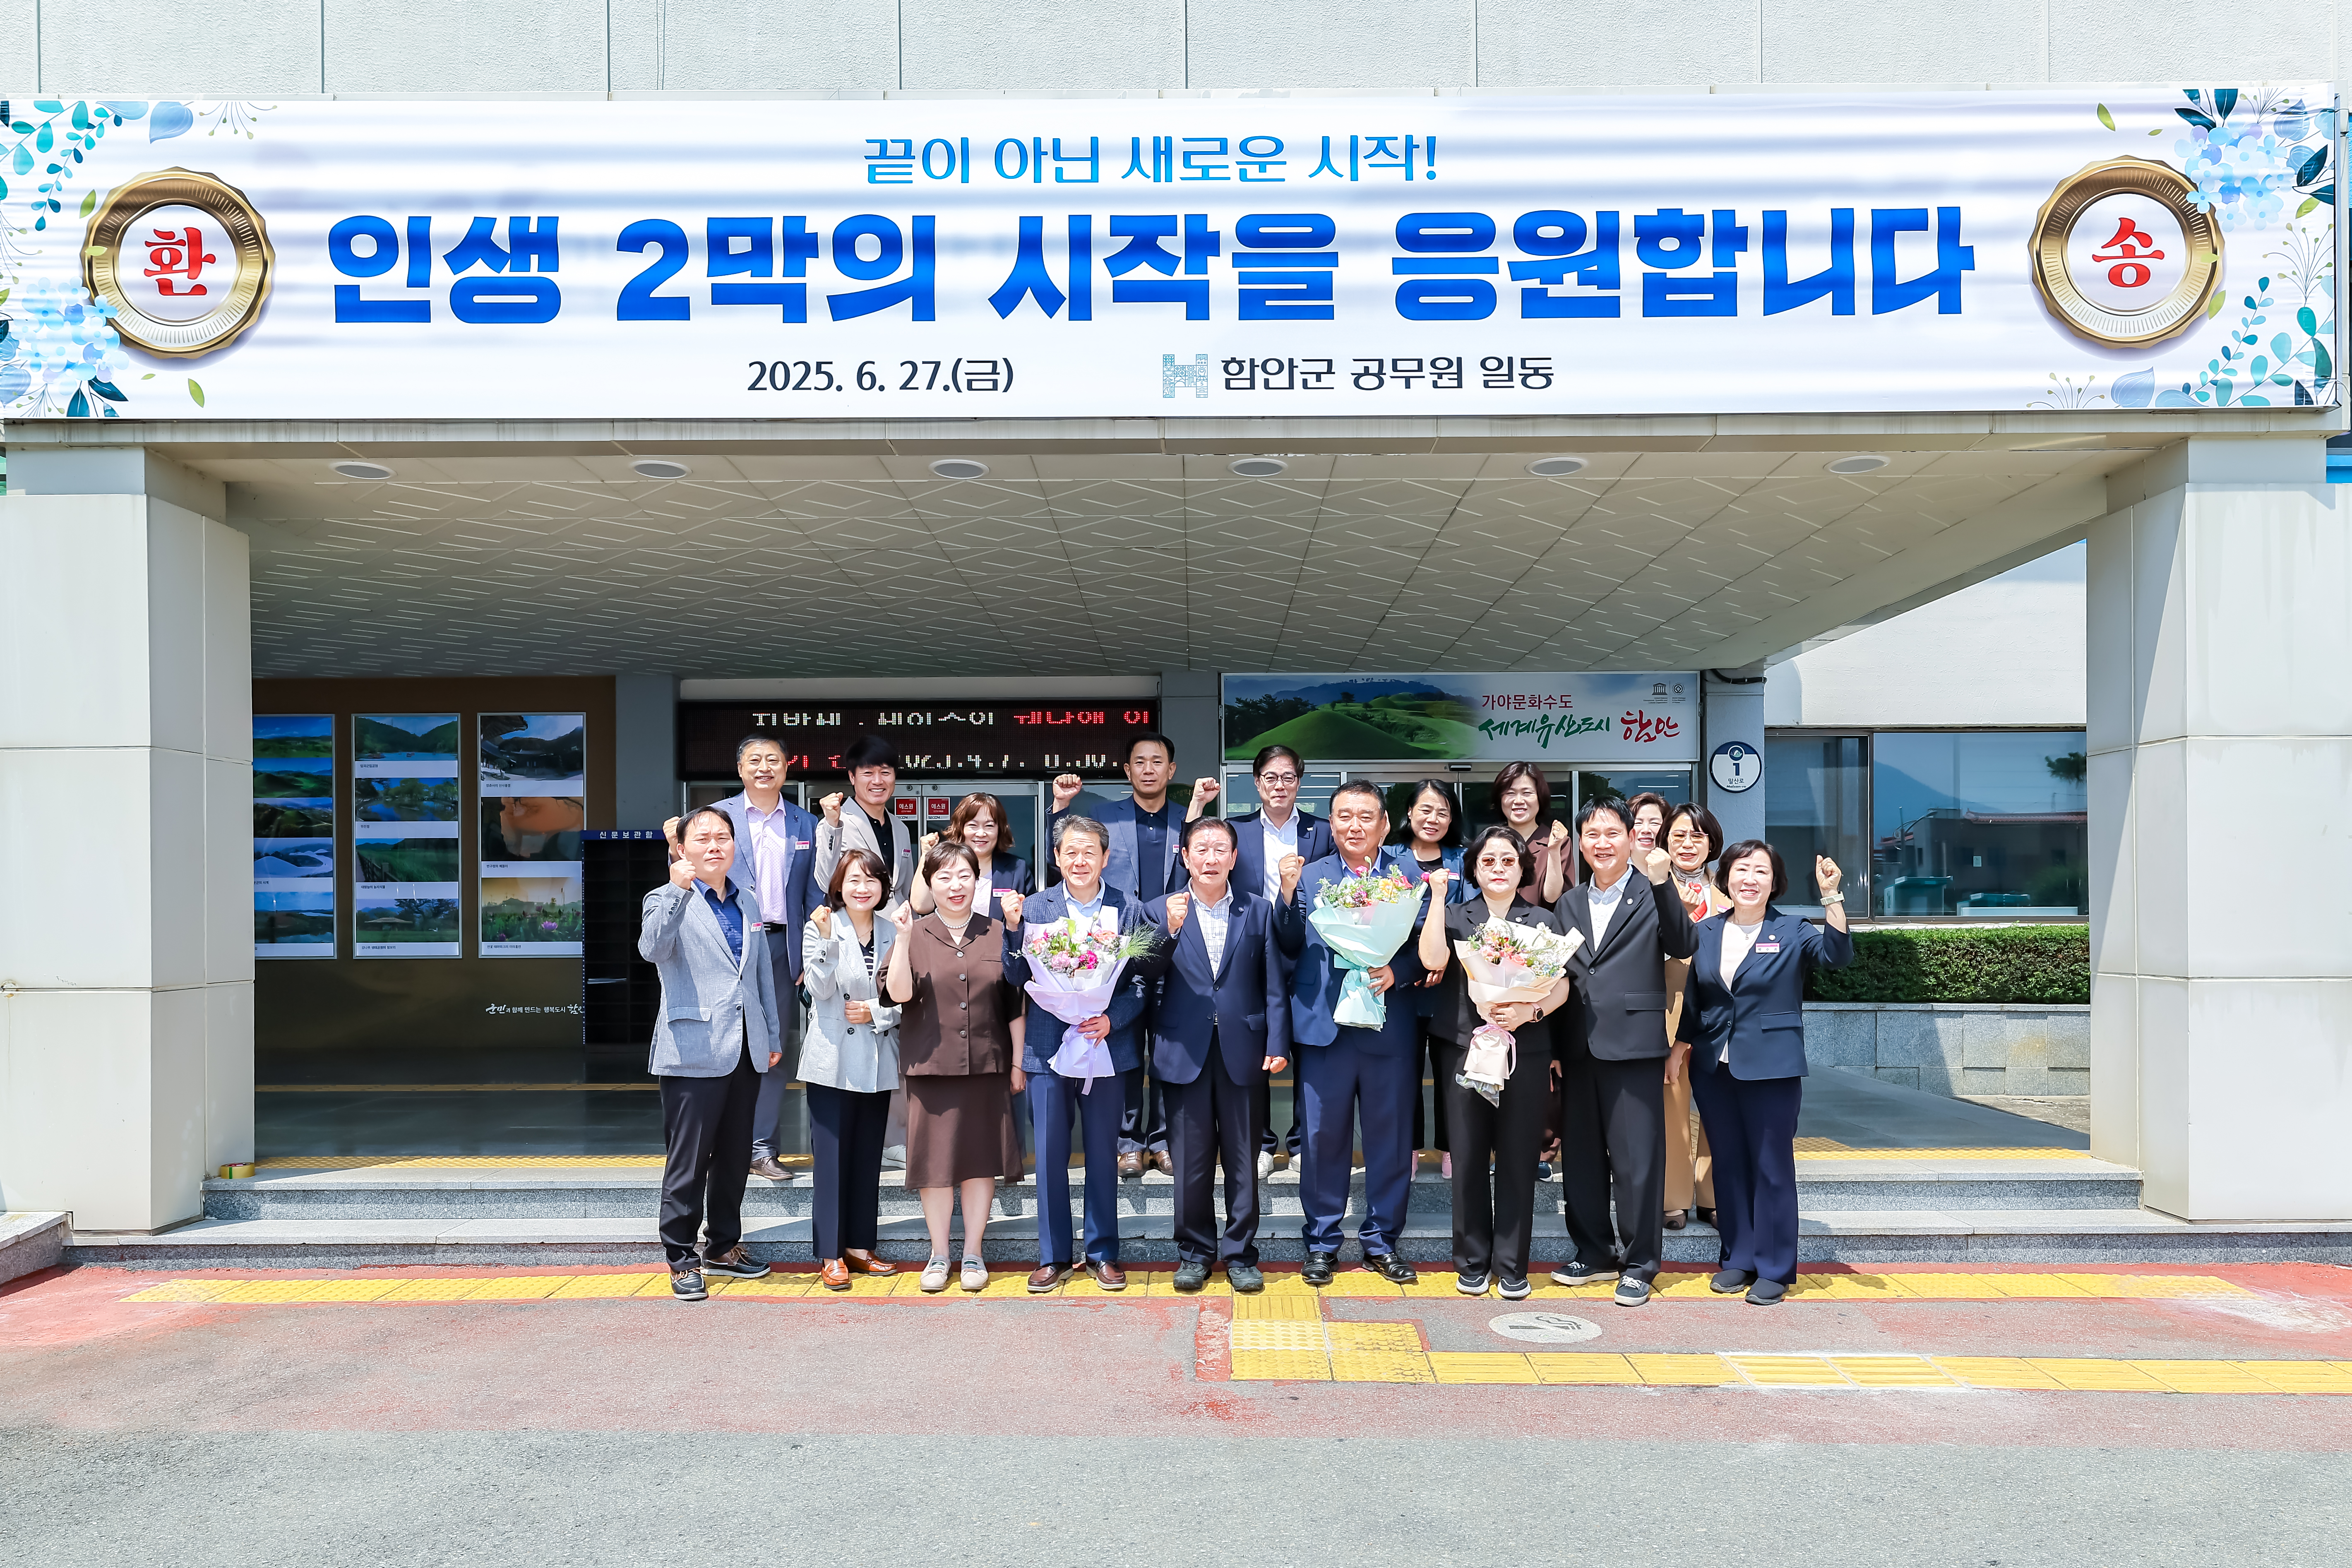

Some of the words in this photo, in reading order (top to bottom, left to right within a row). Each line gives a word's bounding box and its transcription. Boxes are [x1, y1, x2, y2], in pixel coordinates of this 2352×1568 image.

[864, 137, 969, 184] 끝이
[994, 136, 1098, 183] 아닌
[1121, 135, 1286, 182] 새로운
[1308, 134, 1437, 182] 시작!
[144, 227, 216, 296] 환
[328, 215, 561, 324] 인생
[616, 214, 936, 323] 2막의
[987, 213, 1339, 322] 시작을
[1392, 207, 1975, 321] 응원합니다
[2092, 217, 2165, 288] 송
[747, 361, 843, 392] 2025.
[857, 361, 885, 392] 6.
[899, 358, 1014, 393] 27.(금)
[1221, 357, 1336, 390] 함안군
[1351, 357, 1463, 391] 공무원
[1480, 356, 1554, 389] 일동
[1482, 694, 1573, 710] 가야문화수도
[1478, 713, 1610, 749] 세계유산도시
[1620, 709, 1680, 743] 함안
[1733, 763, 1740, 776] 1
[485, 1003, 510, 1014] 군민과
